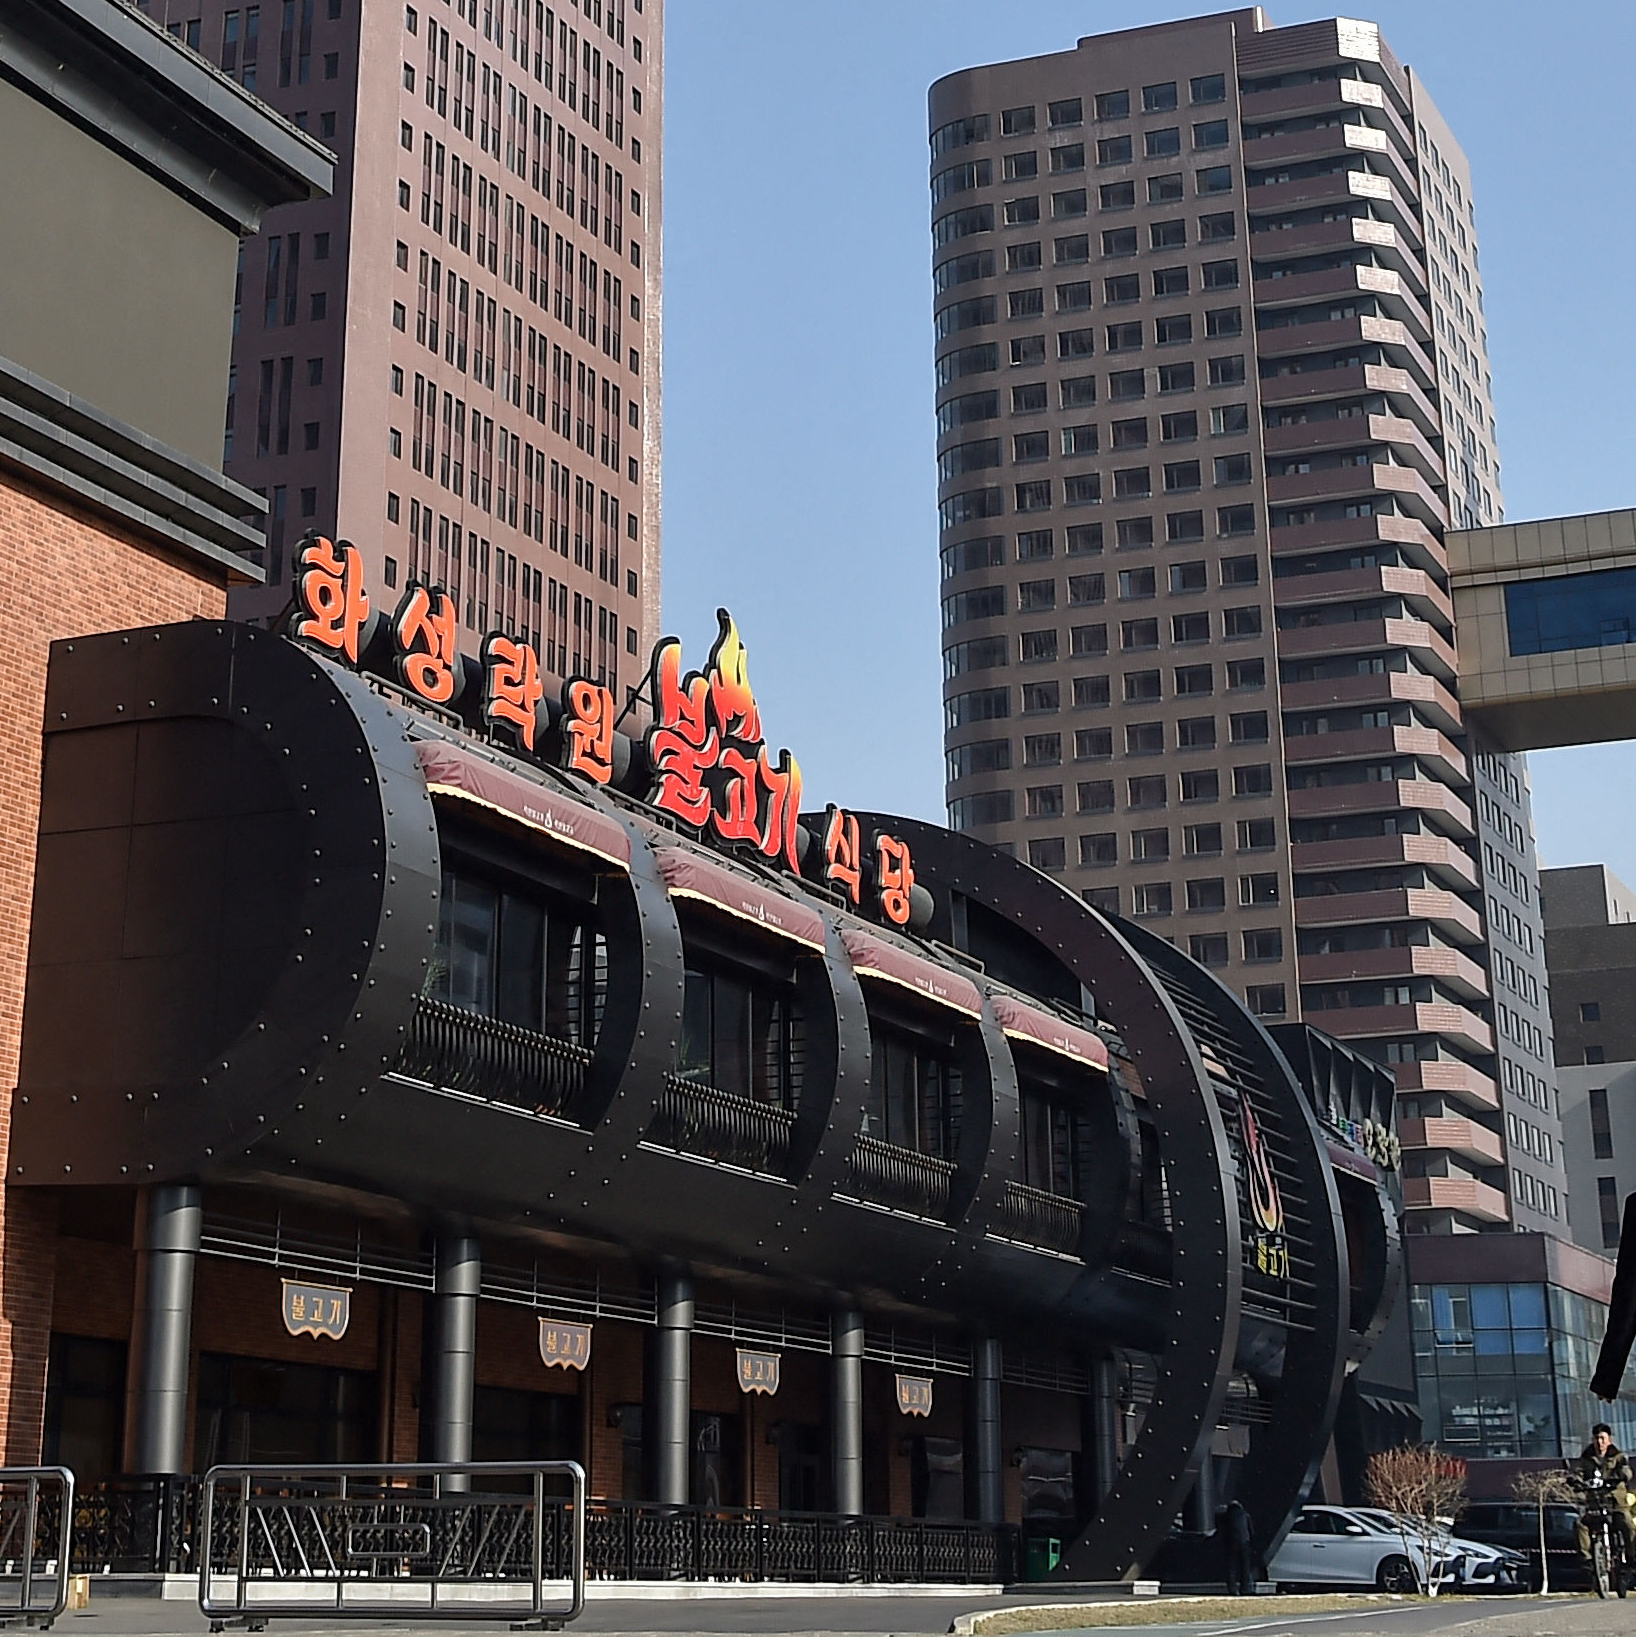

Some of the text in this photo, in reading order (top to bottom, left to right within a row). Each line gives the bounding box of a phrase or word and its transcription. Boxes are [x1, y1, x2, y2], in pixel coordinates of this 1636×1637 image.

[297, 531, 914, 925] 화성락원 불고기 식당
[291, 1293, 342, 1325] 불고기
[546, 1330, 584, 1356] 불고기
[743, 1358, 775, 1382] 불고기
[901, 1384, 929, 1405] 불고기
